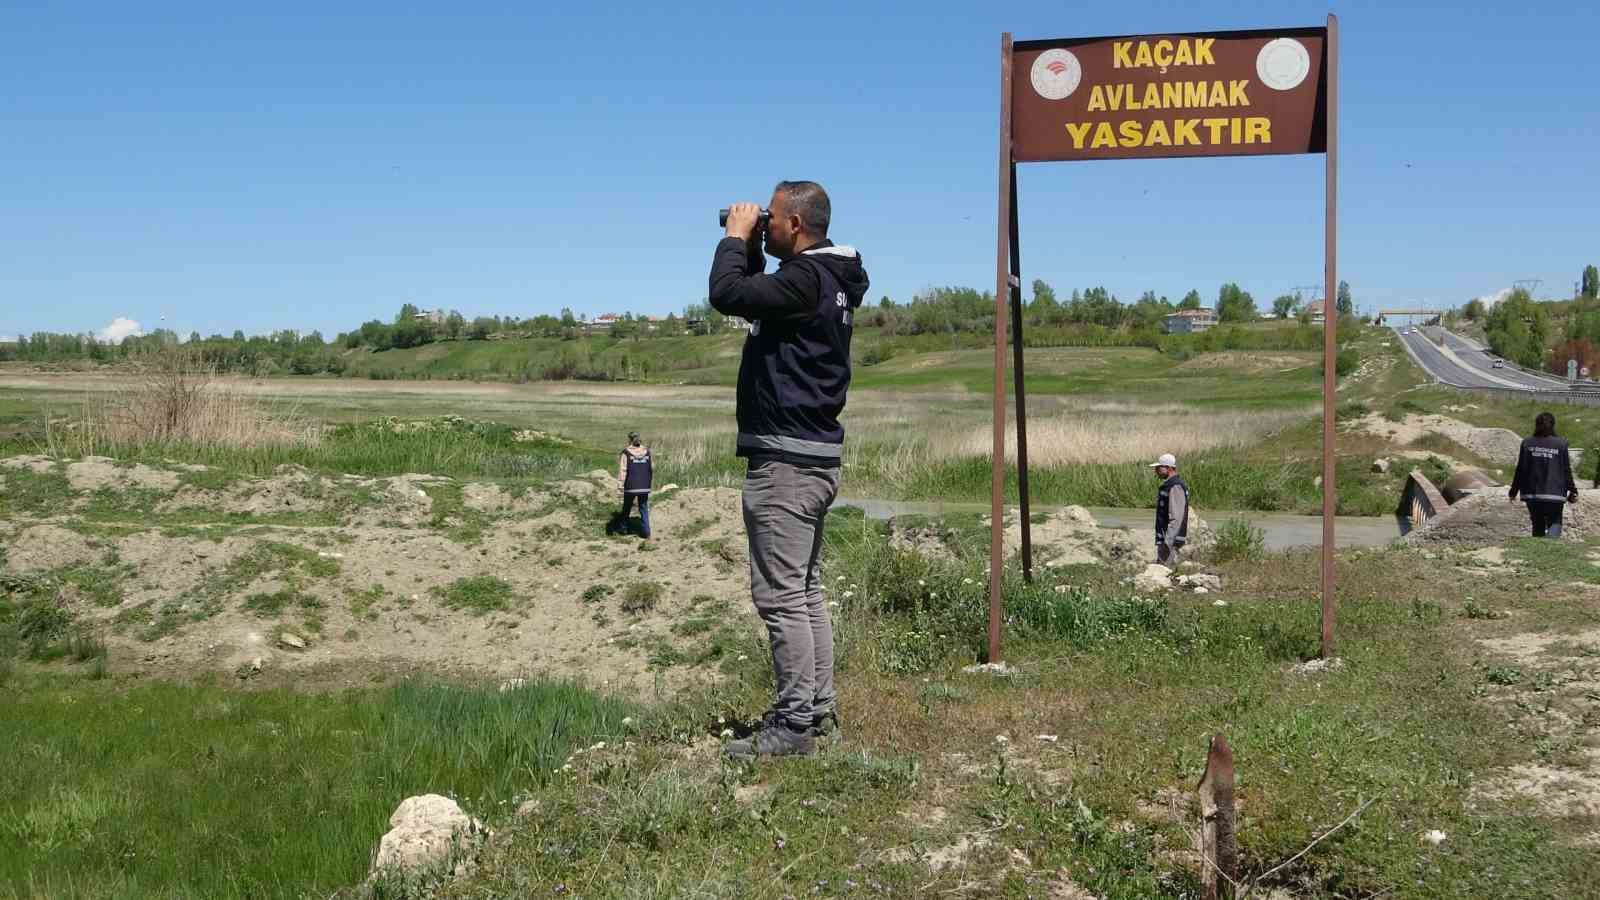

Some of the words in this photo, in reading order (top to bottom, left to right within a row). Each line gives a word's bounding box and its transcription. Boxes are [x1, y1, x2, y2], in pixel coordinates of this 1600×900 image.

[1113, 38, 1215, 73] KAÇAK
[1087, 81, 1250, 112] AVLANMAK
[1065, 117, 1272, 149] YASAKTIR
